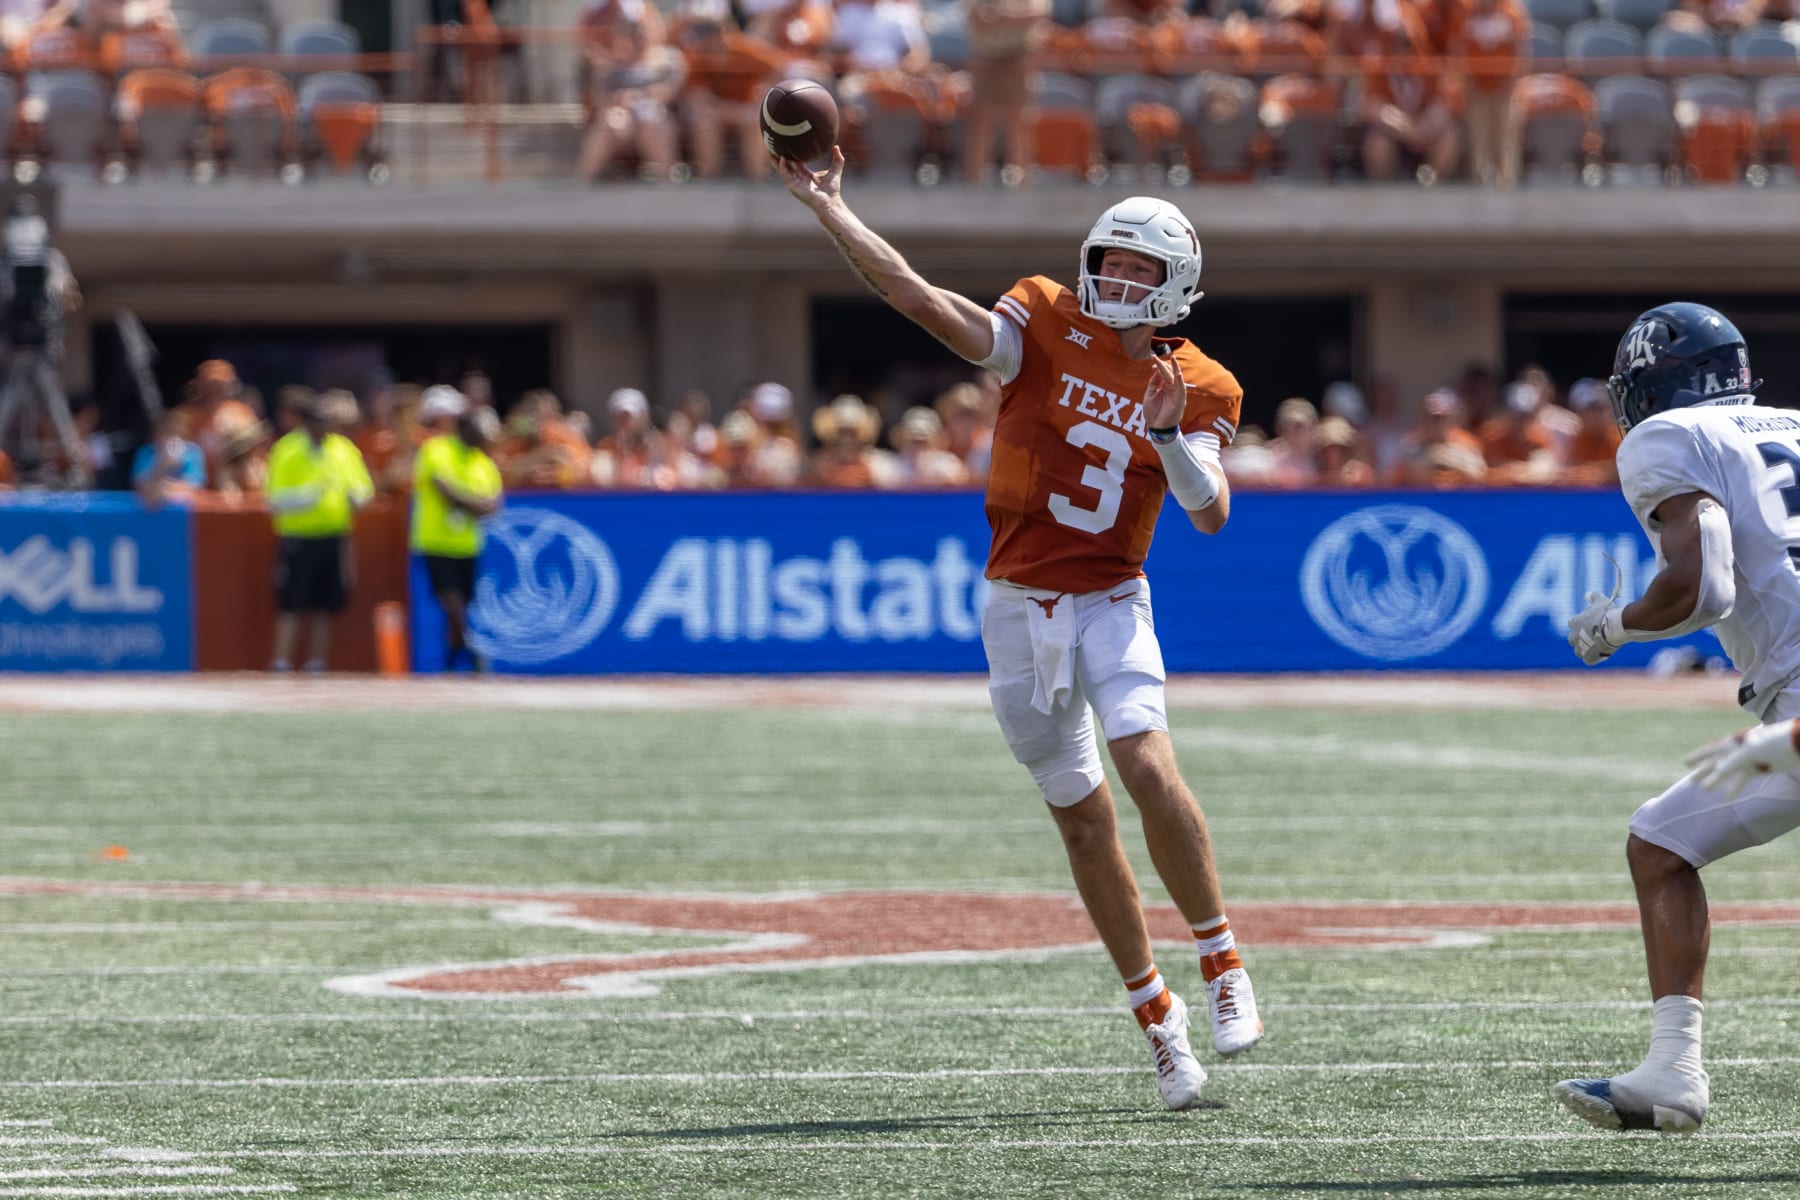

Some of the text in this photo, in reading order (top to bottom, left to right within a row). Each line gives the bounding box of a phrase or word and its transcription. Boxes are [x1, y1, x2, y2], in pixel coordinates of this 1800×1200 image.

[1058, 372, 1151, 441] TEXA
[1726, 377, 1738, 390] 33
[1048, 420, 1133, 535] 3
[1756, 440, 1800, 572] 3
[0, 533, 166, 615] ELL
